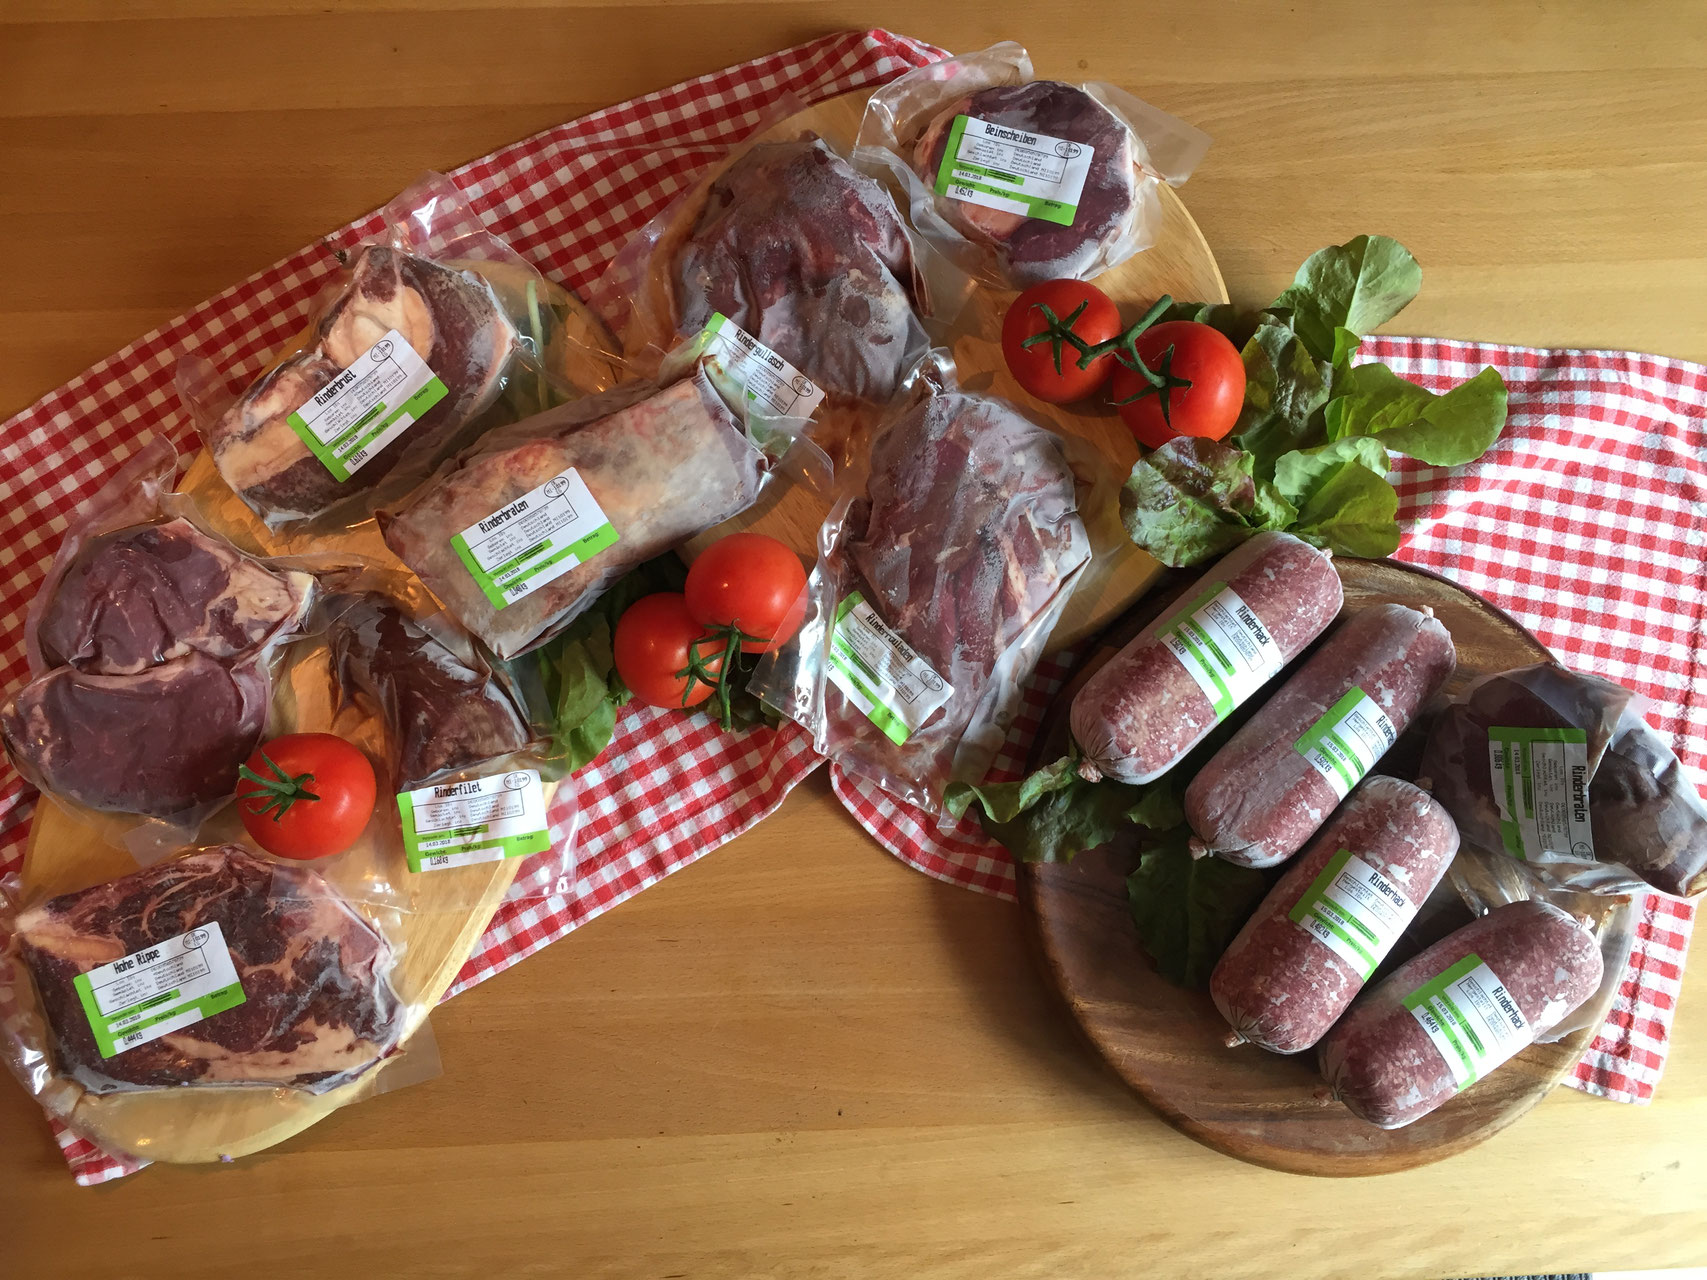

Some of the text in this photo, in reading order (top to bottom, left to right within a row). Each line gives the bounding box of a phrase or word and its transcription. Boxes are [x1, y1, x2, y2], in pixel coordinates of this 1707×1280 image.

[985, 125, 1037, 145] Beinscheiben
[734, 330, 785, 373] Rindergullasch
[315, 369, 357, 406] Rinderbrust
[479, 498, 529, 534] Rinderbraten
[866, 612, 914, 663] Rinderrouladen
[1236, 605, 1270, 647] Rinderhack
[434, 781, 481, 799] Rinderfilet
[1572, 767, 1588, 822] Rinderbraten
[1367, 873, 1409, 908] Rinderhack
[114, 958, 134, 974] Hohe
[136, 947, 161, 966] Rippe
[1492, 987, 1526, 1030] Rinderhack
